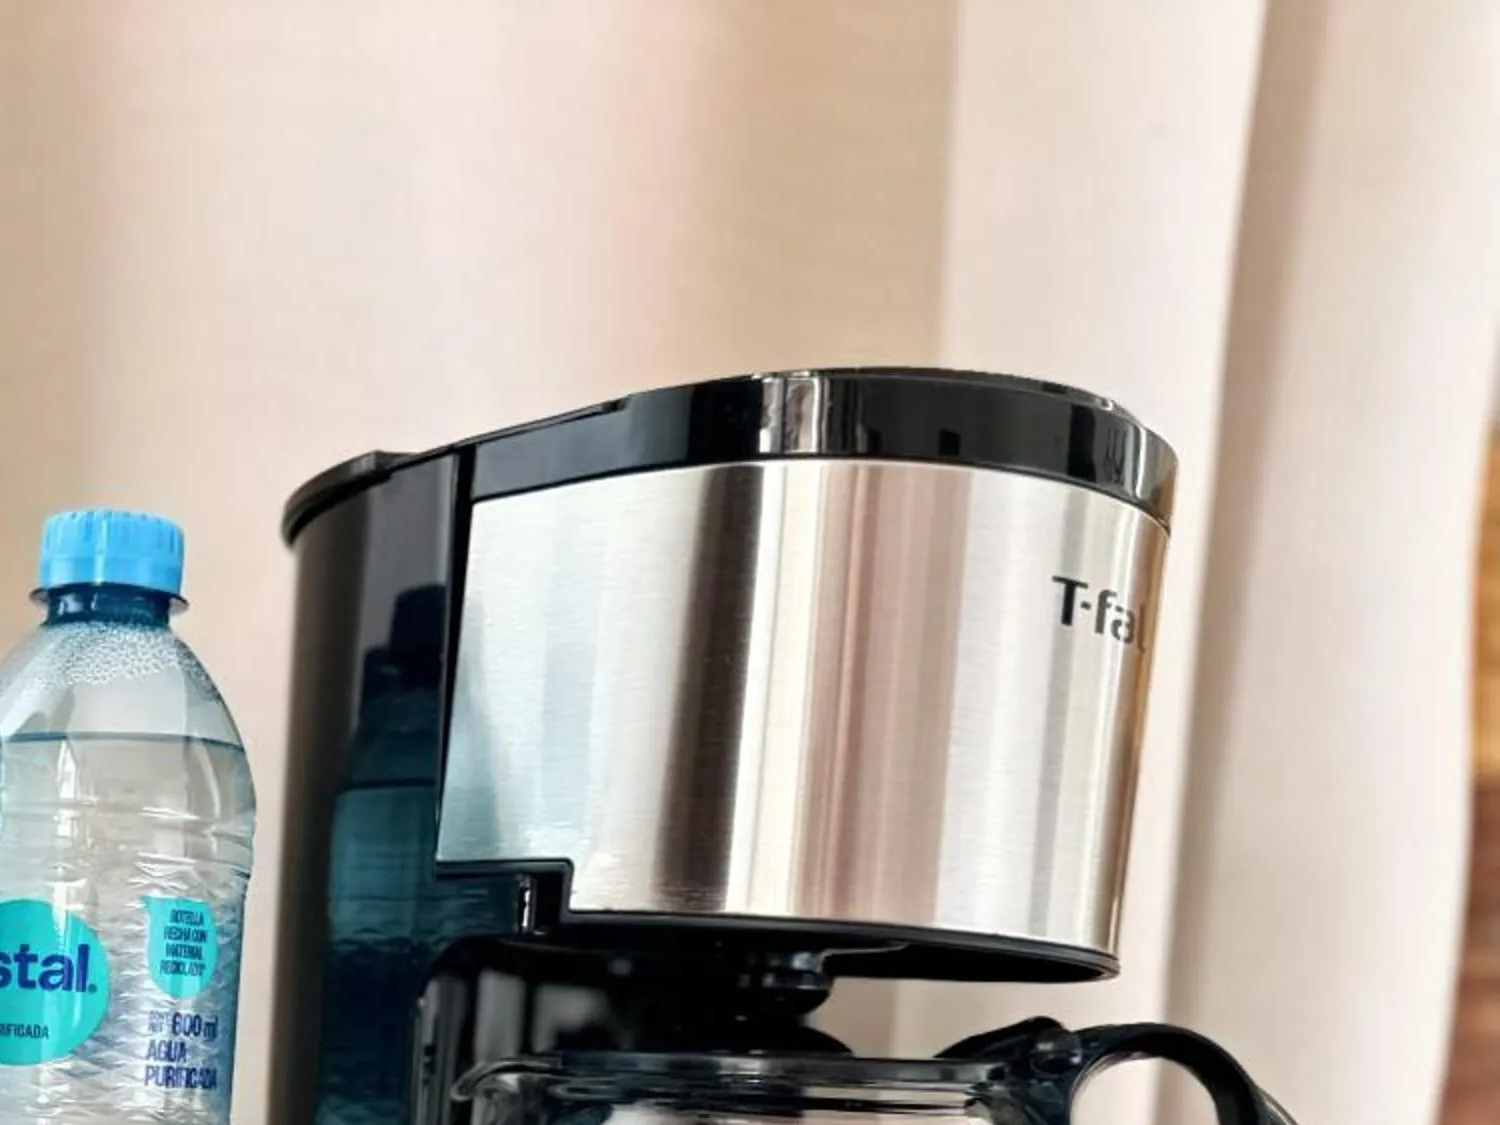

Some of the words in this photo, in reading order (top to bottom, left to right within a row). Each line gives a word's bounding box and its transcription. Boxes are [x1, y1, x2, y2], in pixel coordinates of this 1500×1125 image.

[171, 1011, 202, 1036] 600
[146, 1039, 187, 1062] AGUA
[144, 1065, 217, 1090] PURIFICADA
